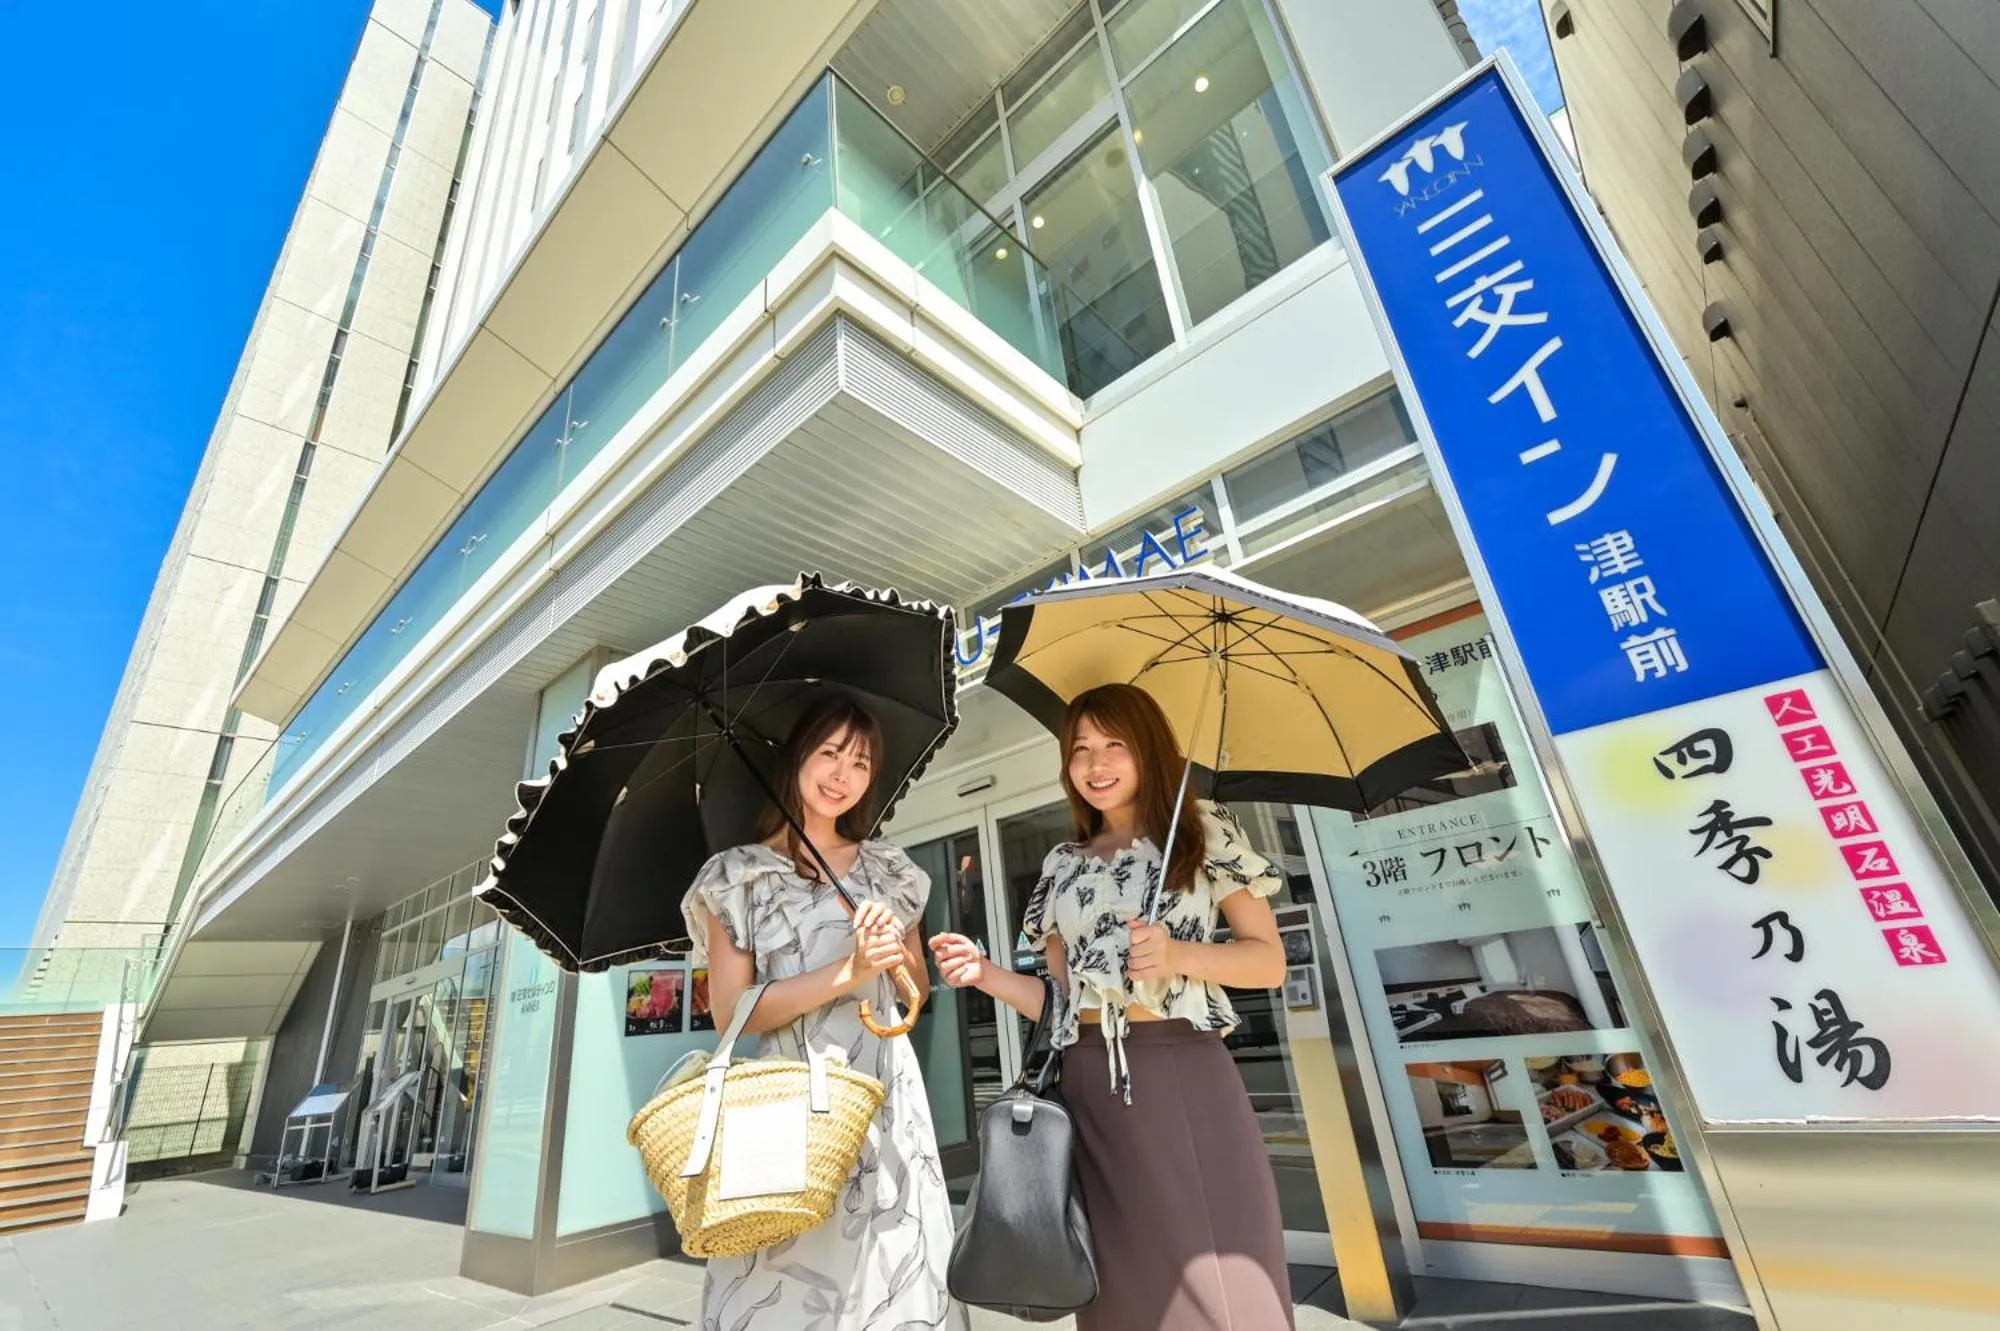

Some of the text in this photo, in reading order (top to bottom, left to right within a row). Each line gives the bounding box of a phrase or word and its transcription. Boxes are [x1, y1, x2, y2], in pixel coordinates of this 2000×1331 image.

[1417, 189, 1688, 681] 三交イン 津駅前
[1362, 826, 1551, 888] 3階 フロント
[1397, 813, 1480, 840] ENTRANCE
[1653, 727, 1891, 1090] 四季乃湯
[1770, 693, 1941, 965] 人工光明石温泉
